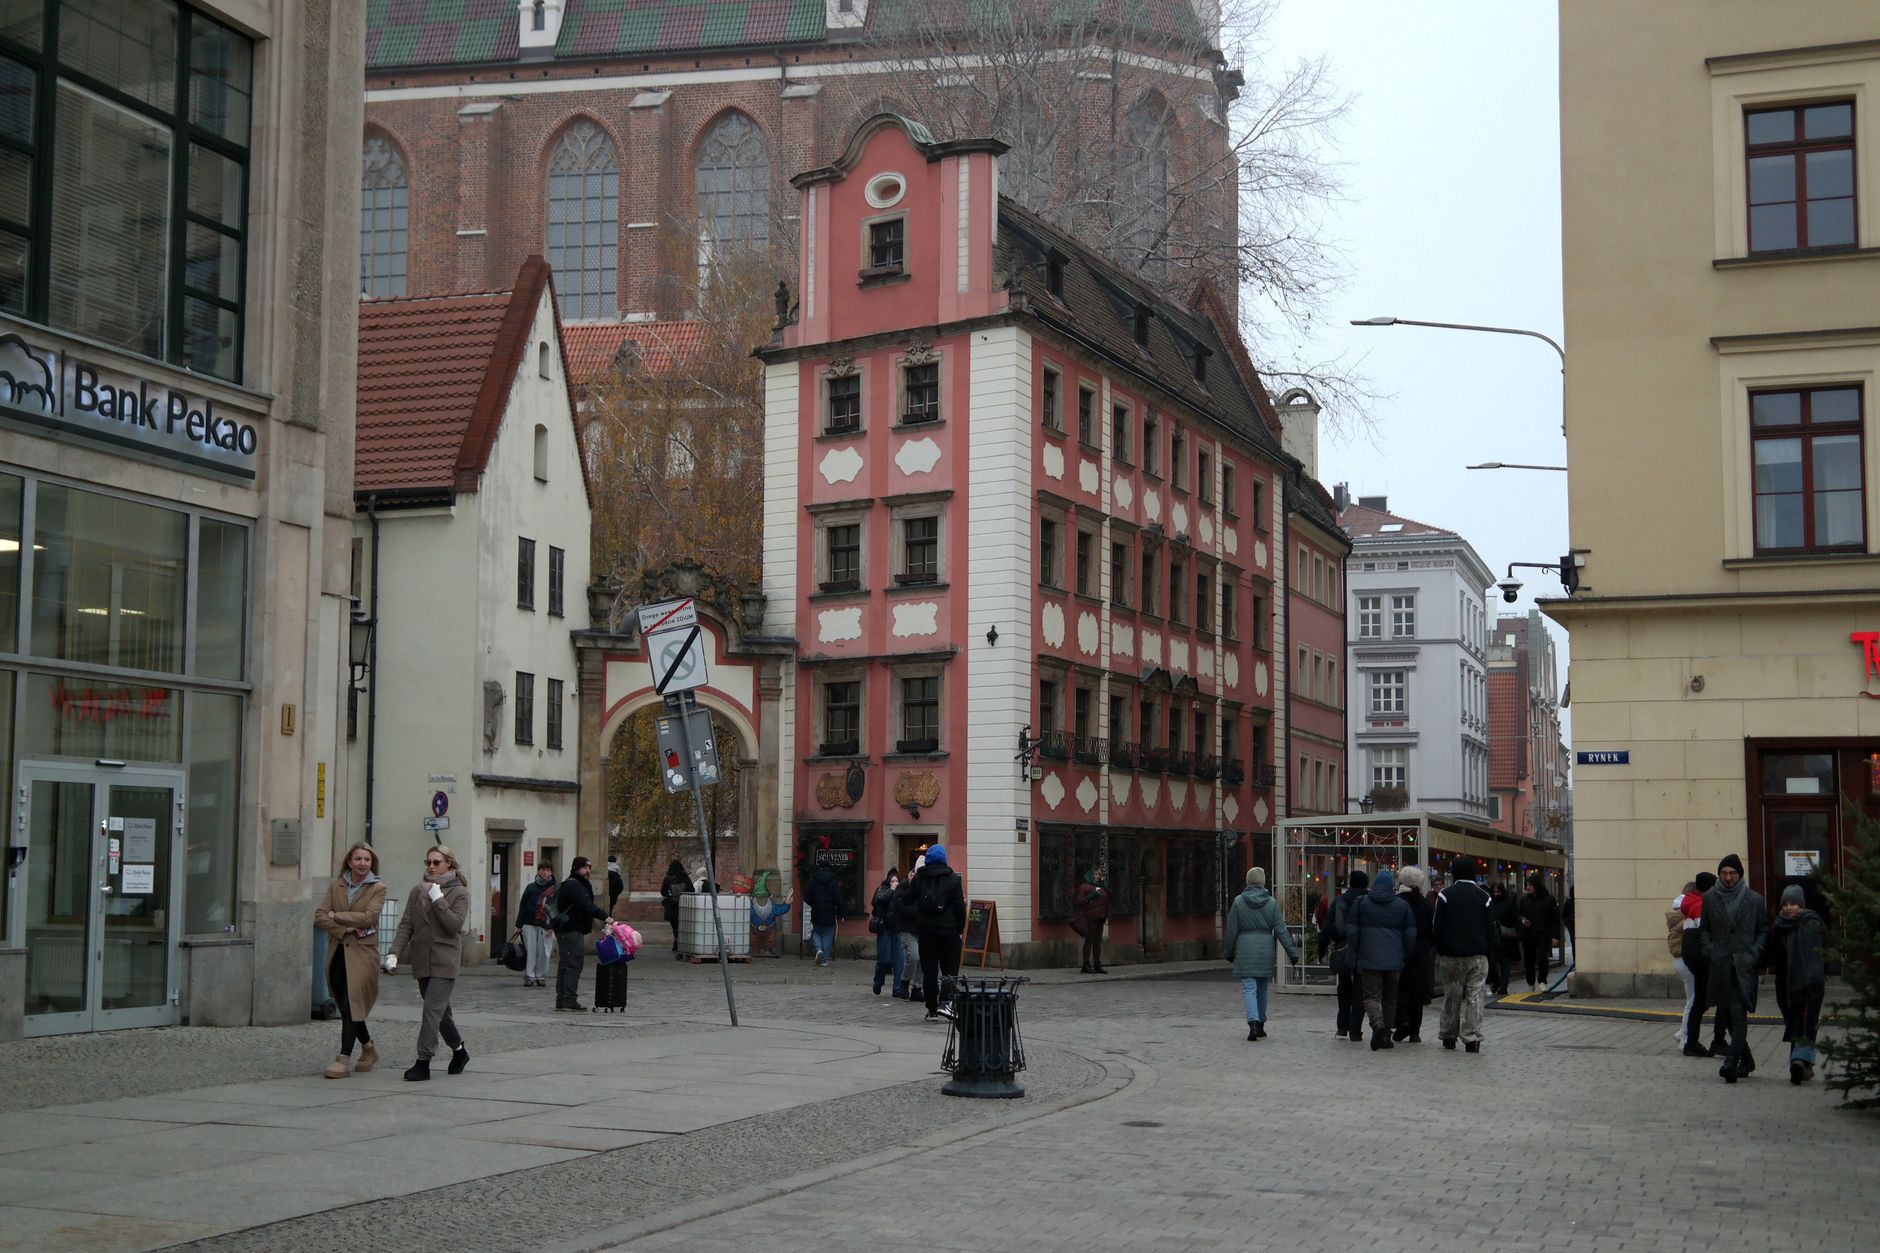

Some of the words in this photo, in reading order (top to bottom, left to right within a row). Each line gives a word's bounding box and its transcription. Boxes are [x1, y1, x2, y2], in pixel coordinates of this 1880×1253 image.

[74, 363, 158, 430] Bank
[166, 390, 257, 456] Pekao
[1588, 753, 1619, 762] RYNEK
